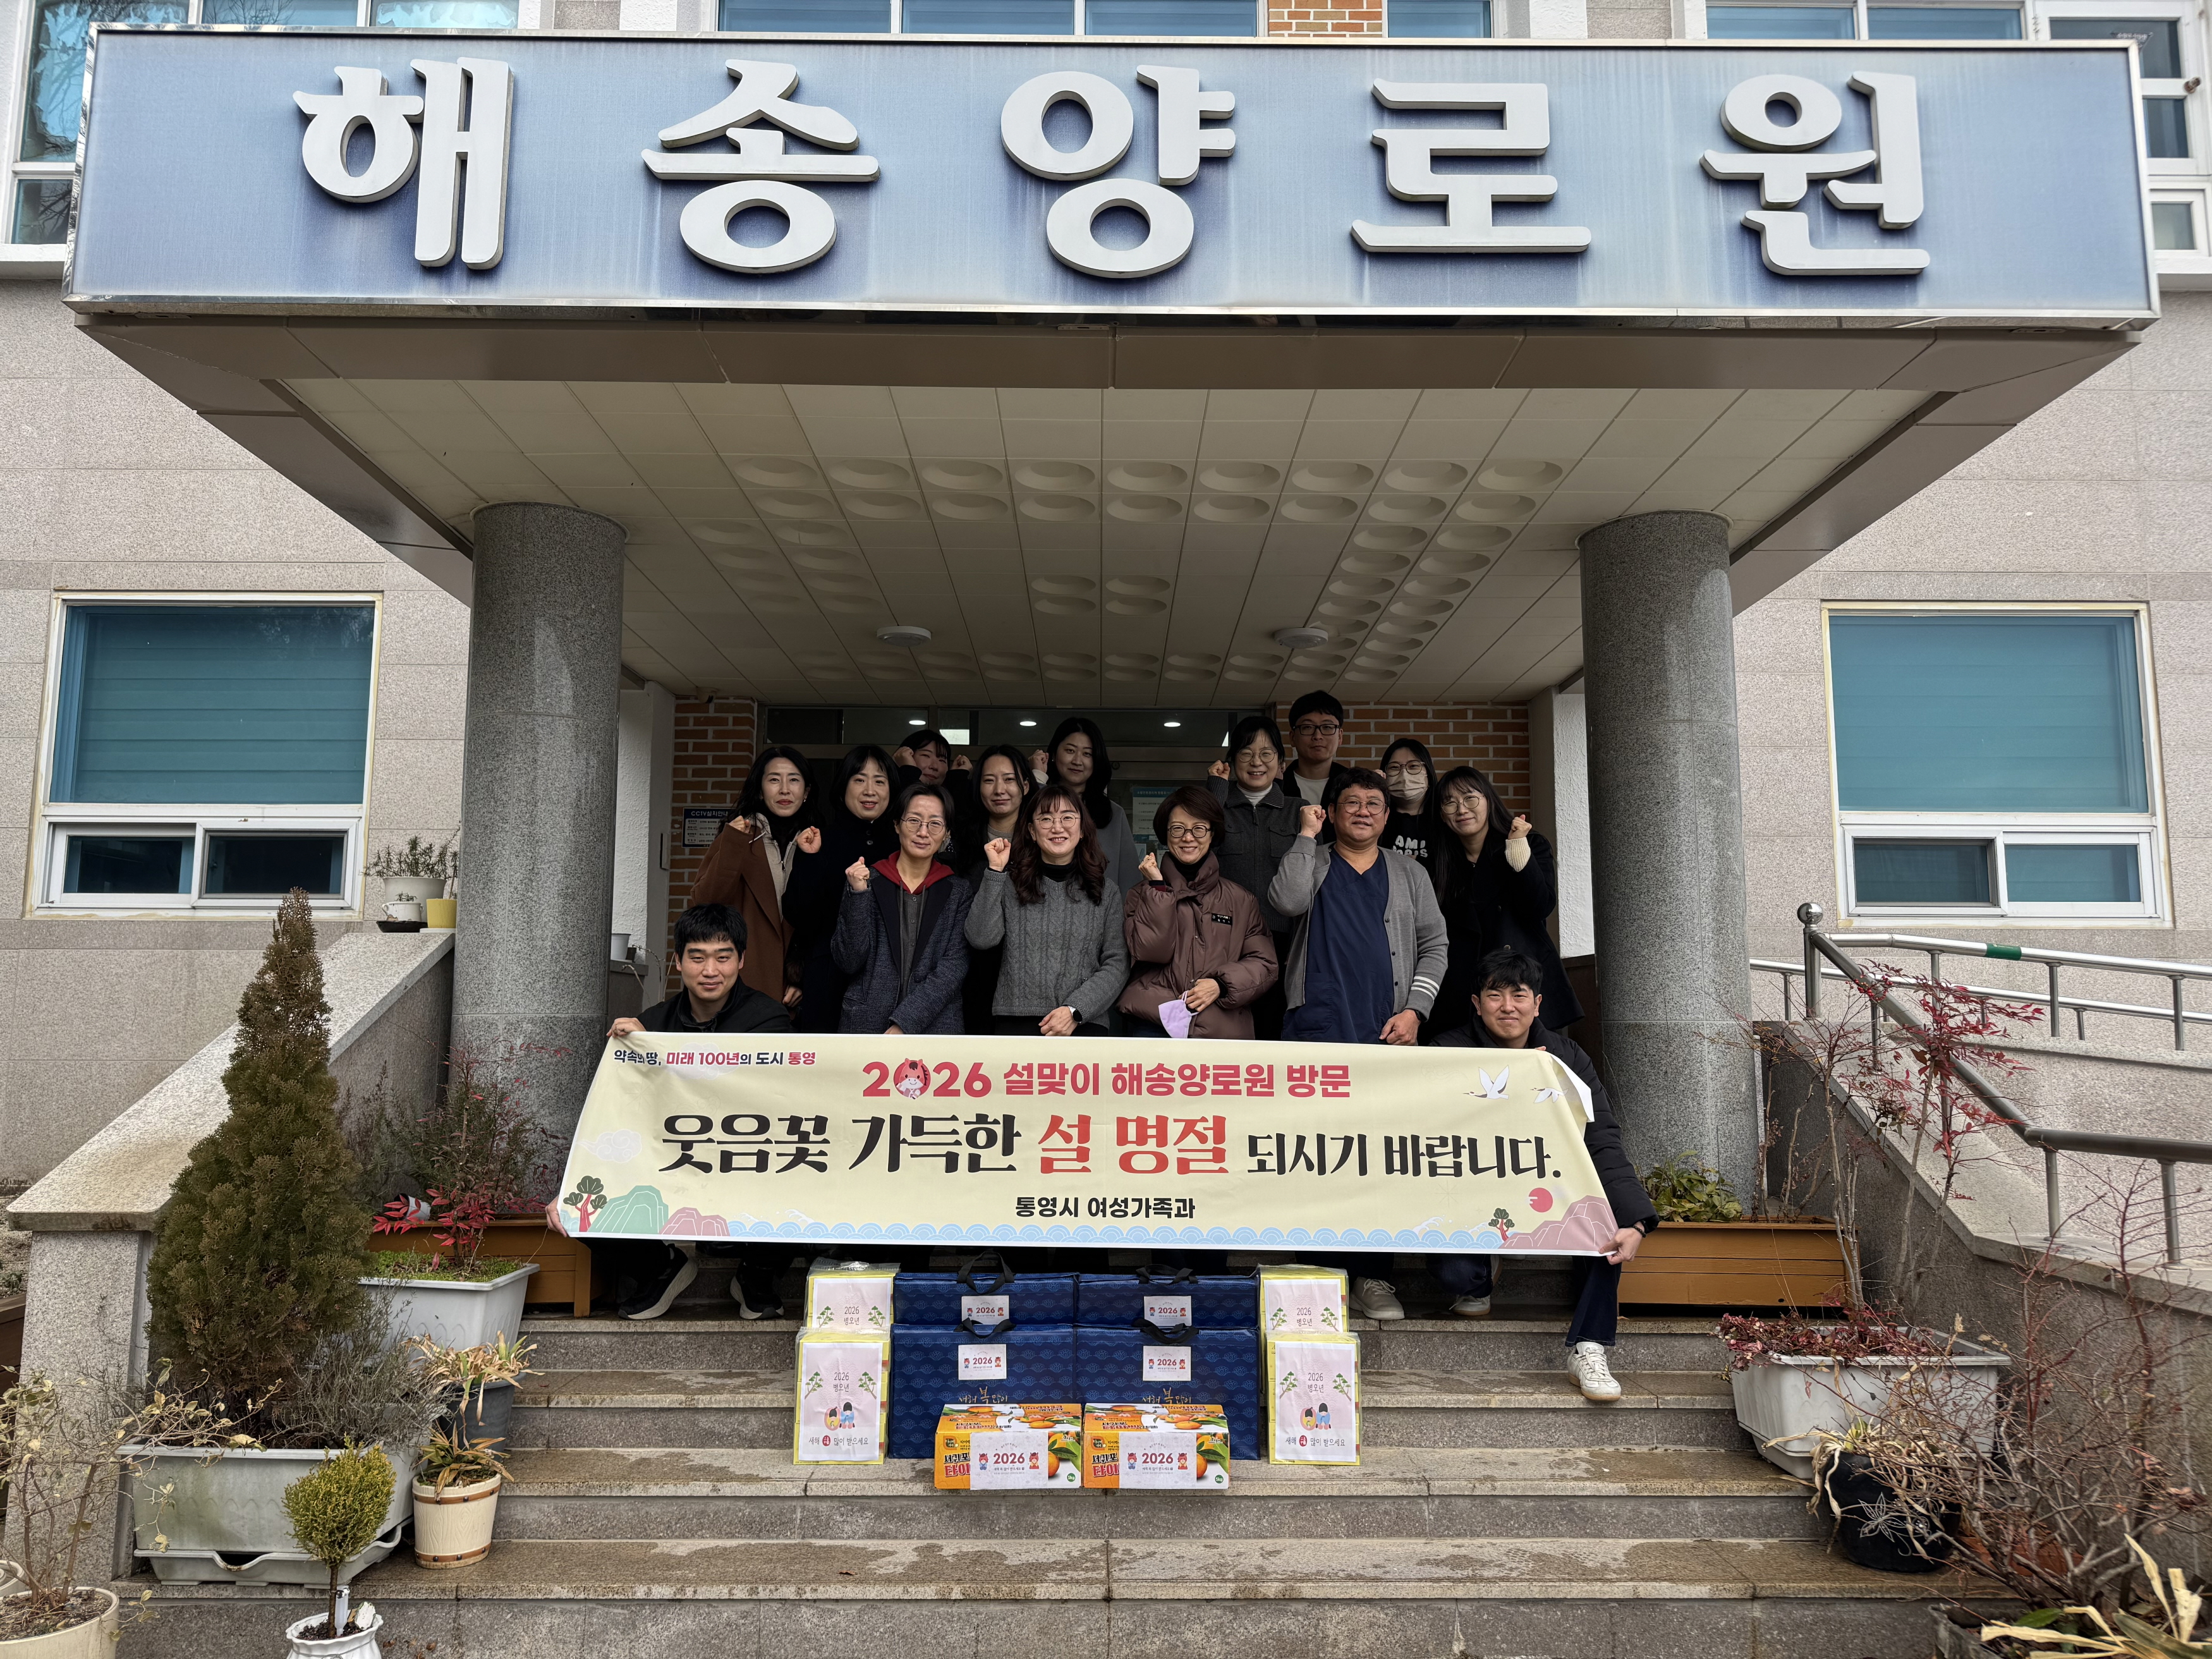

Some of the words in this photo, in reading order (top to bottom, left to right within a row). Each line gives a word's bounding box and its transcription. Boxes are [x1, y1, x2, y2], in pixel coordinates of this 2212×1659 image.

[293, 56, 1930, 279] 해송양로원
[1395, 835, 1426, 849] AMI
[614, 1050, 645, 1064] 약속의
[646, 1052, 661, 1066] 땅,
[667, 1052, 694, 1065] 미래
[699, 1052, 751, 1066] 100년의
[756, 1052, 783, 1065] 도시
[788, 1052, 816, 1066] 통영
[1004, 1063, 1100, 1096] 설맞이
[1111, 1063, 1275, 1097] 해송양로원
[1287, 1064, 1351, 1098] 방문
[658, 1114, 831, 1174] 웃음꽃
[848, 1113, 1022, 1174] 가득한
[1038, 1114, 1092, 1174] 설
[1116, 1114, 1229, 1175] 명절
[1247, 1133, 1368, 1177] 되시기
[1383, 1134, 1561, 1179] 바랍니다.
[1015, 1196, 1079, 1218] 통영시
[1087, 1197, 1196, 1219] 여성가족과
[844, 1306, 860, 1315] 2026
[1296, 1307, 1311, 1315] 2026
[844, 1316, 860, 1326] 병오년
[1296, 1318, 1312, 1327] 병오년
[834, 1372, 849, 1381] 2026
[1308, 1373, 1323, 1381] 2026
[833, 1383, 849, 1392] 병오년
[1308, 1384, 1324, 1393] 병오년
[958, 1395, 977, 1403] 새해
[979, 1386, 990, 1404] 복
[992, 1394, 1007, 1403] 많이
[1163, 1387, 1174, 1404] 복
[1176, 1395, 1191, 1404] 많이
[809, 1437, 820, 1445] 새해
[834, 1437, 844, 1446] 많이
[847, 1437, 868, 1446] 받으세요
[1285, 1437, 1296, 1445] 새해
[1310, 1438, 1321, 1447] 많이
[1323, 1438, 1345, 1447] 받으세요
[944, 1452, 970, 1463] 서귀포
[994, 1452, 1025, 1464] 2026
[1092, 1452, 1119, 1463] 서귀포
[1142, 1452, 1174, 1464] 2026
